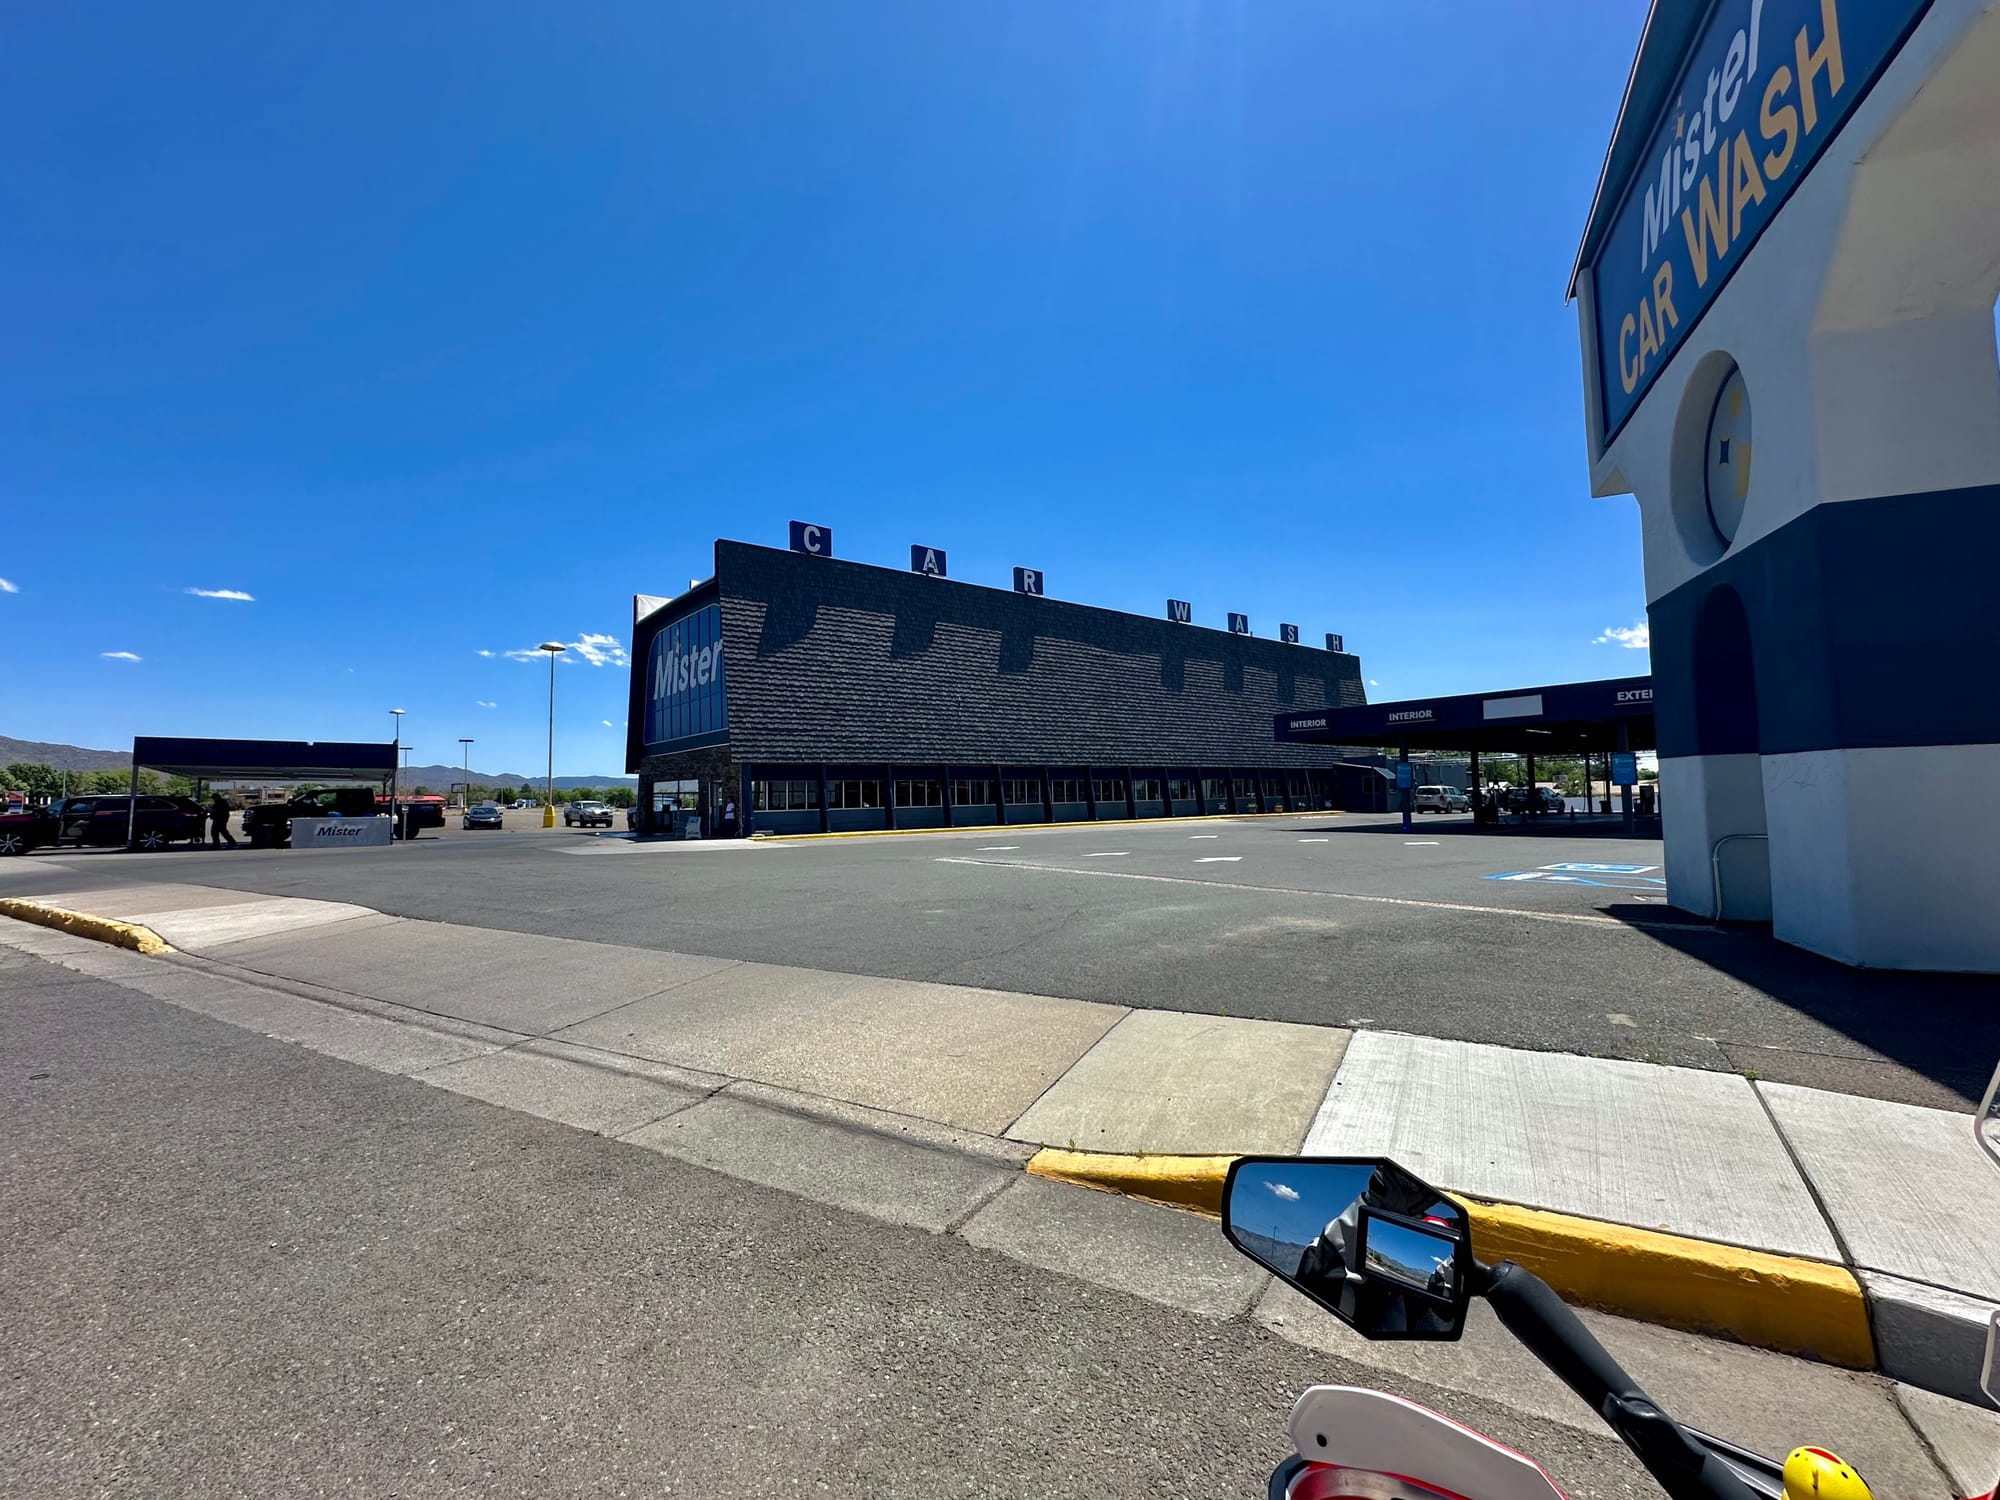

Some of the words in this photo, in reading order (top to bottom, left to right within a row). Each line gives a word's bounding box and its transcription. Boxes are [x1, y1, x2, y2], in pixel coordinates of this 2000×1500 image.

[1619, 260, 1679, 394] CAR
[1681, 0, 1845, 288] WASH
[653, 638, 723, 700] Mister
[1617, 689, 1653, 701] EXTE
[1388, 709, 1432, 721] INTERIOR
[1290, 718, 1327, 729] INTERIOR
[317, 826, 362, 837] Mister
